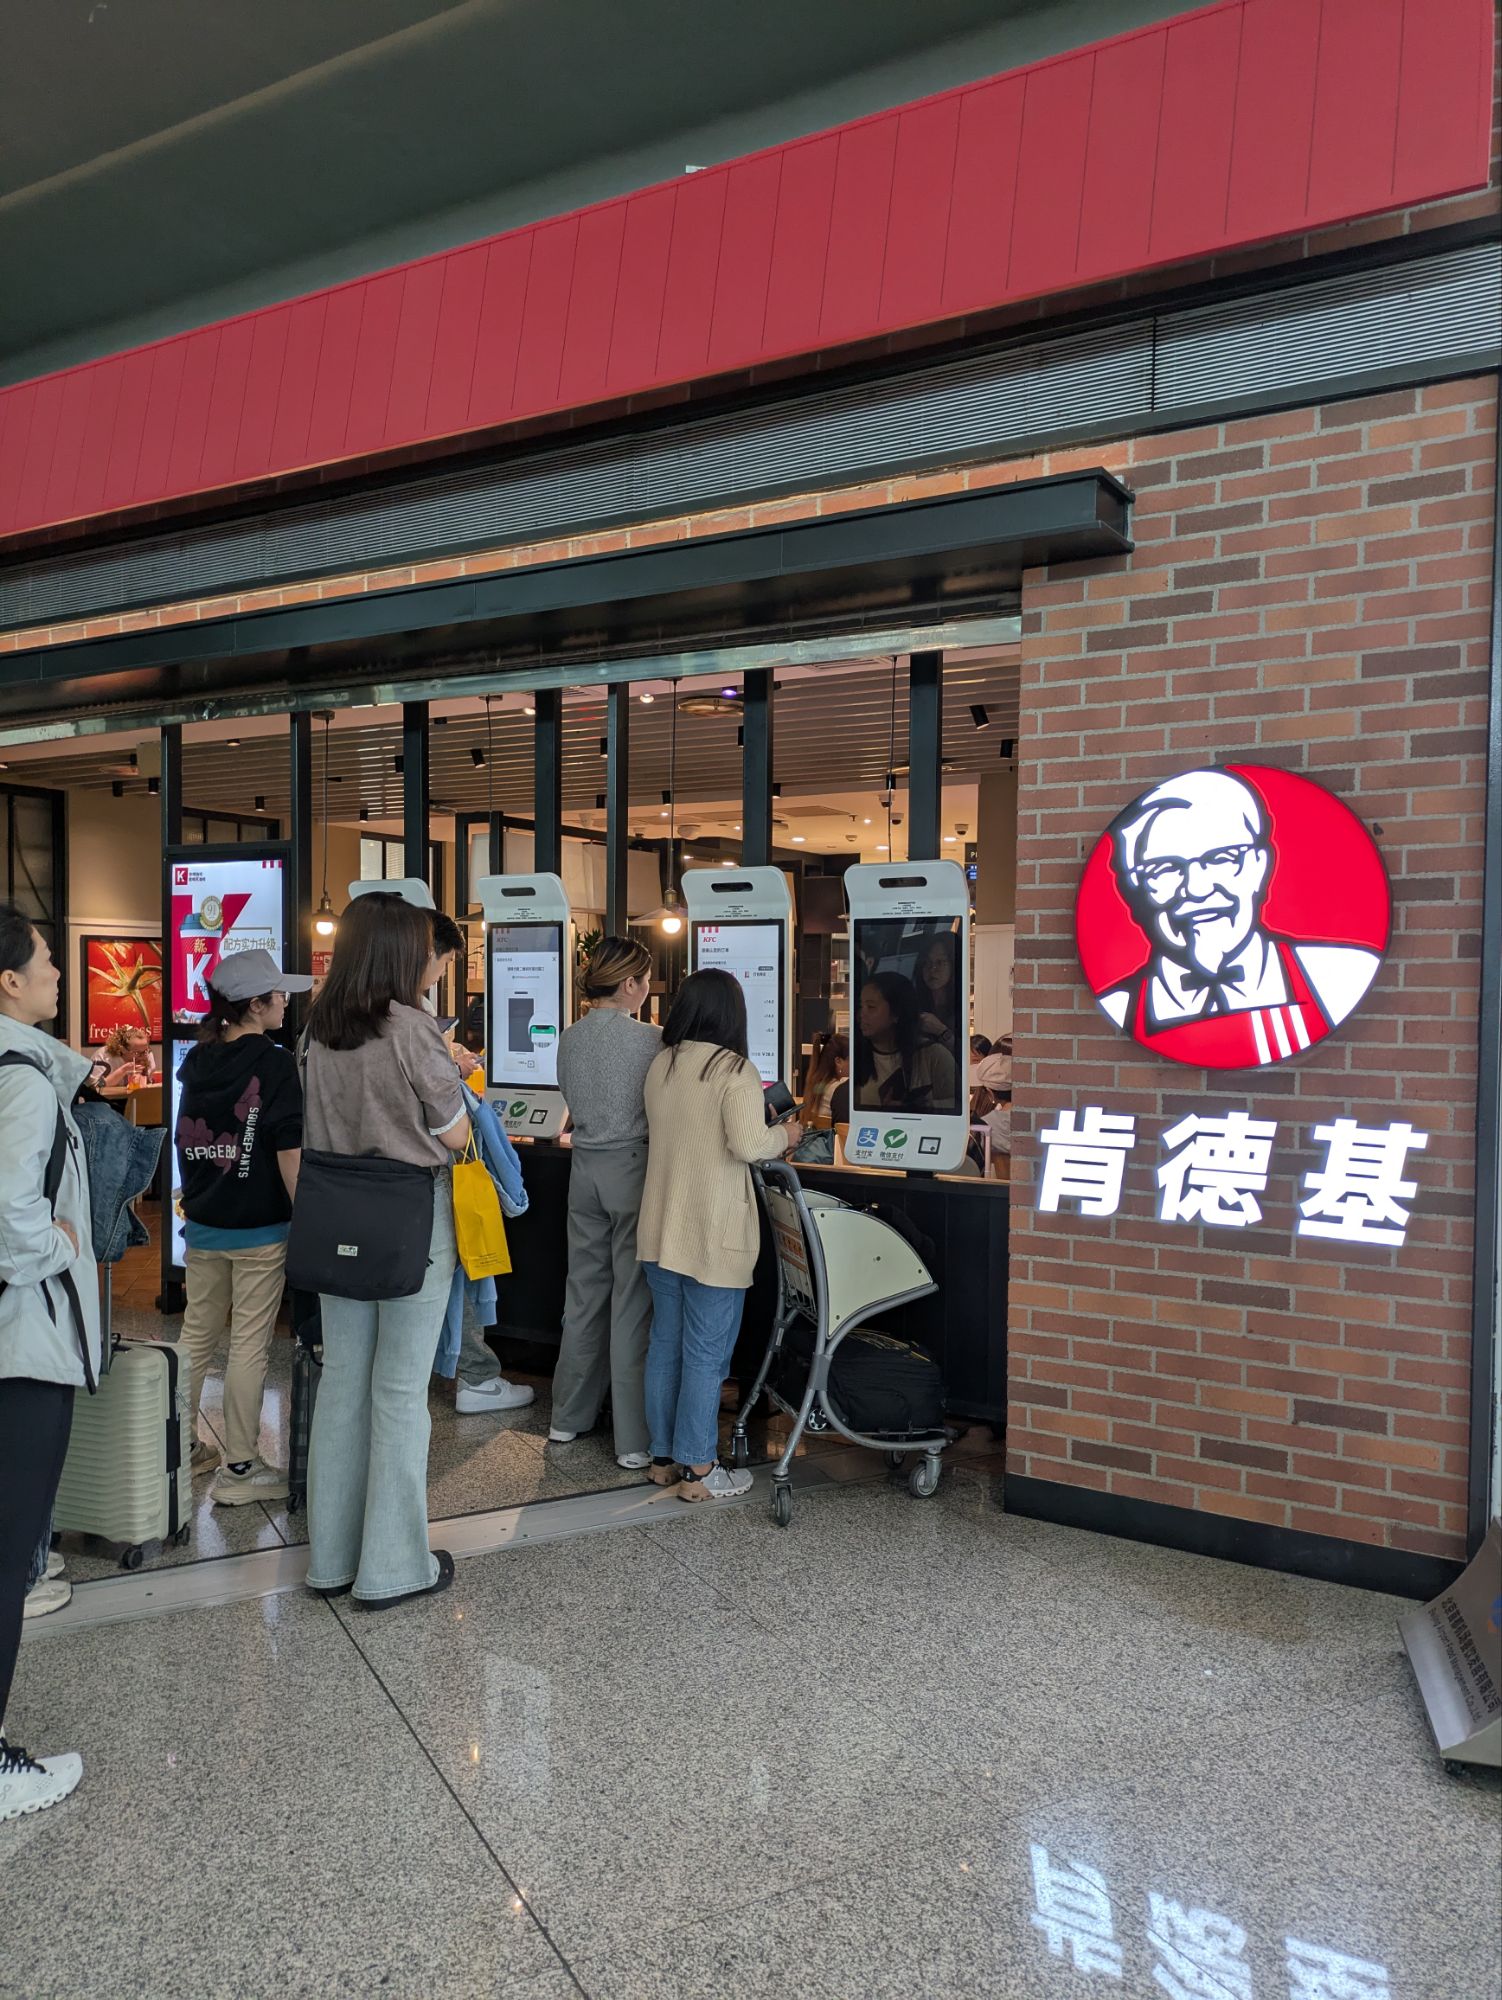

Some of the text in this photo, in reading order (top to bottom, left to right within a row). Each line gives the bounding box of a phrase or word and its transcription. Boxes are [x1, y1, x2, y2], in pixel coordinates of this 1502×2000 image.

[177, 870, 186, 883] K
[855, 1149, 874, 1158] 支付宝
[879, 1151, 904, 1160] 微信支付
[1037, 1106, 1429, 1247] 肯德基
